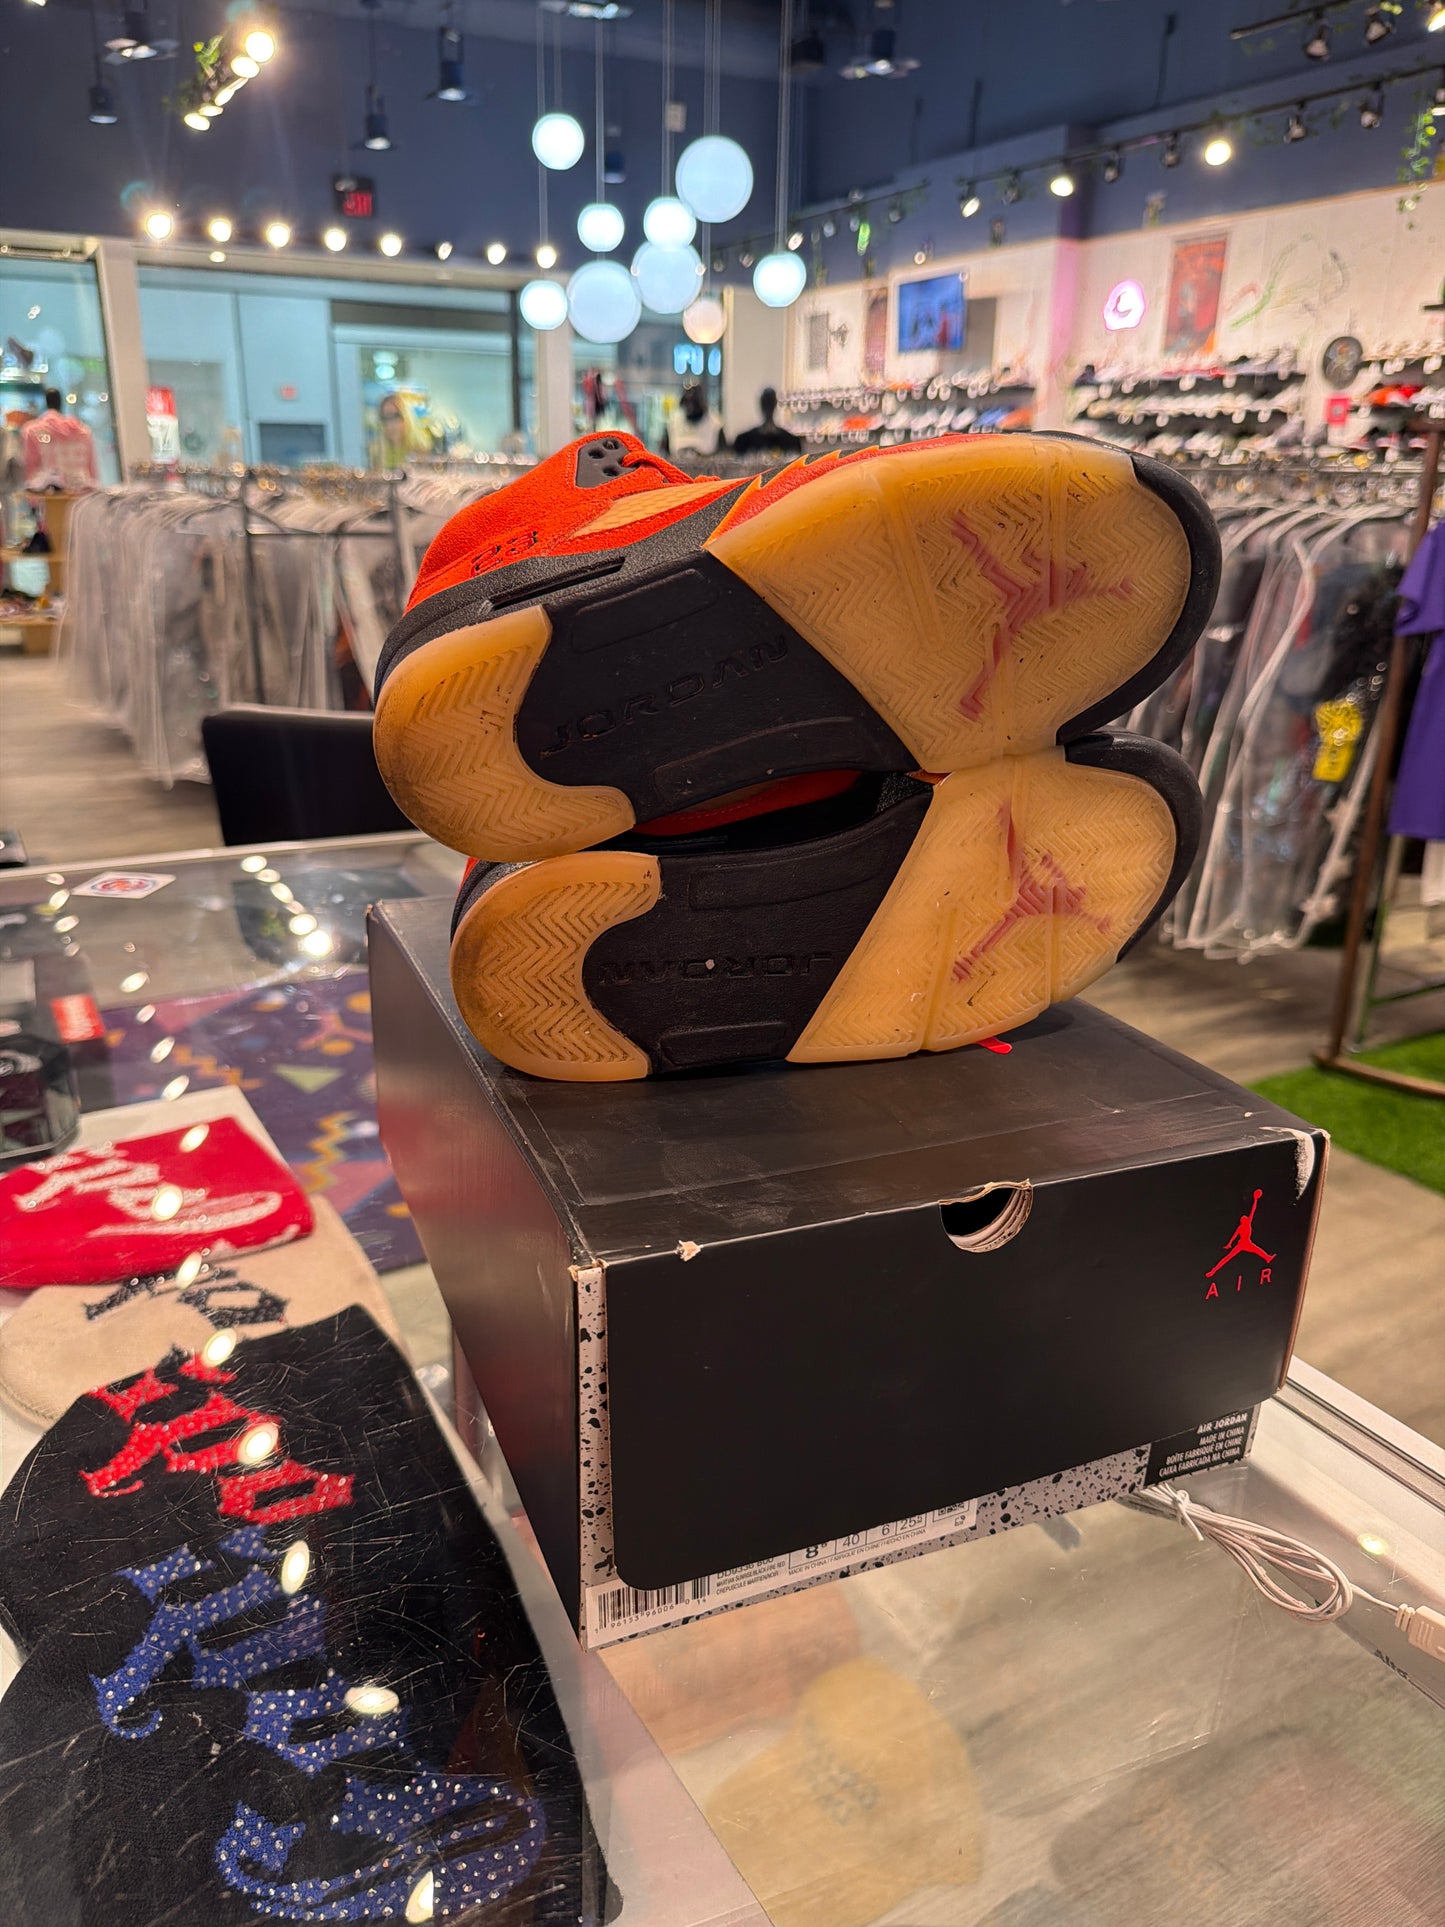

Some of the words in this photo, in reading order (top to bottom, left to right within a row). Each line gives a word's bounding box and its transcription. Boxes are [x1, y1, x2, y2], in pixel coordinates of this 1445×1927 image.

[470, 529, 539, 577] 23
[539, 633, 789, 760] JORDAN
[597, 951, 833, 986] JORDAN
[1205, 1267, 1272, 1300] AIR
[1197, 1421, 1213, 1434] AIR
[1213, 1412, 1248, 1430] JORDAN
[1199, 1433, 1217, 1446] MADE
[1217, 1431, 1225, 1440] IN
[1226, 1426, 1245, 1438] CHINA
[1215, 1441, 1224, 1451] EN
[1224, 1436, 1243, 1449] CHINE
[1159, 1464, 1177, 1477] CAIXA
[1178, 1455, 1211, 1472] FABRICADA
[1211, 1452, 1221, 1462] NA
[1221, 1446, 1240, 1460] CHINA
[842, 1533, 861, 1547] 40
[881, 1523, 891, 1536] 6
[788, 1567, 804, 1576] MADE
[811, 1559, 827, 1569] CHINA
[864, 1542, 881, 1553] CHINE
[910, 1528, 926, 1539] CHINA
